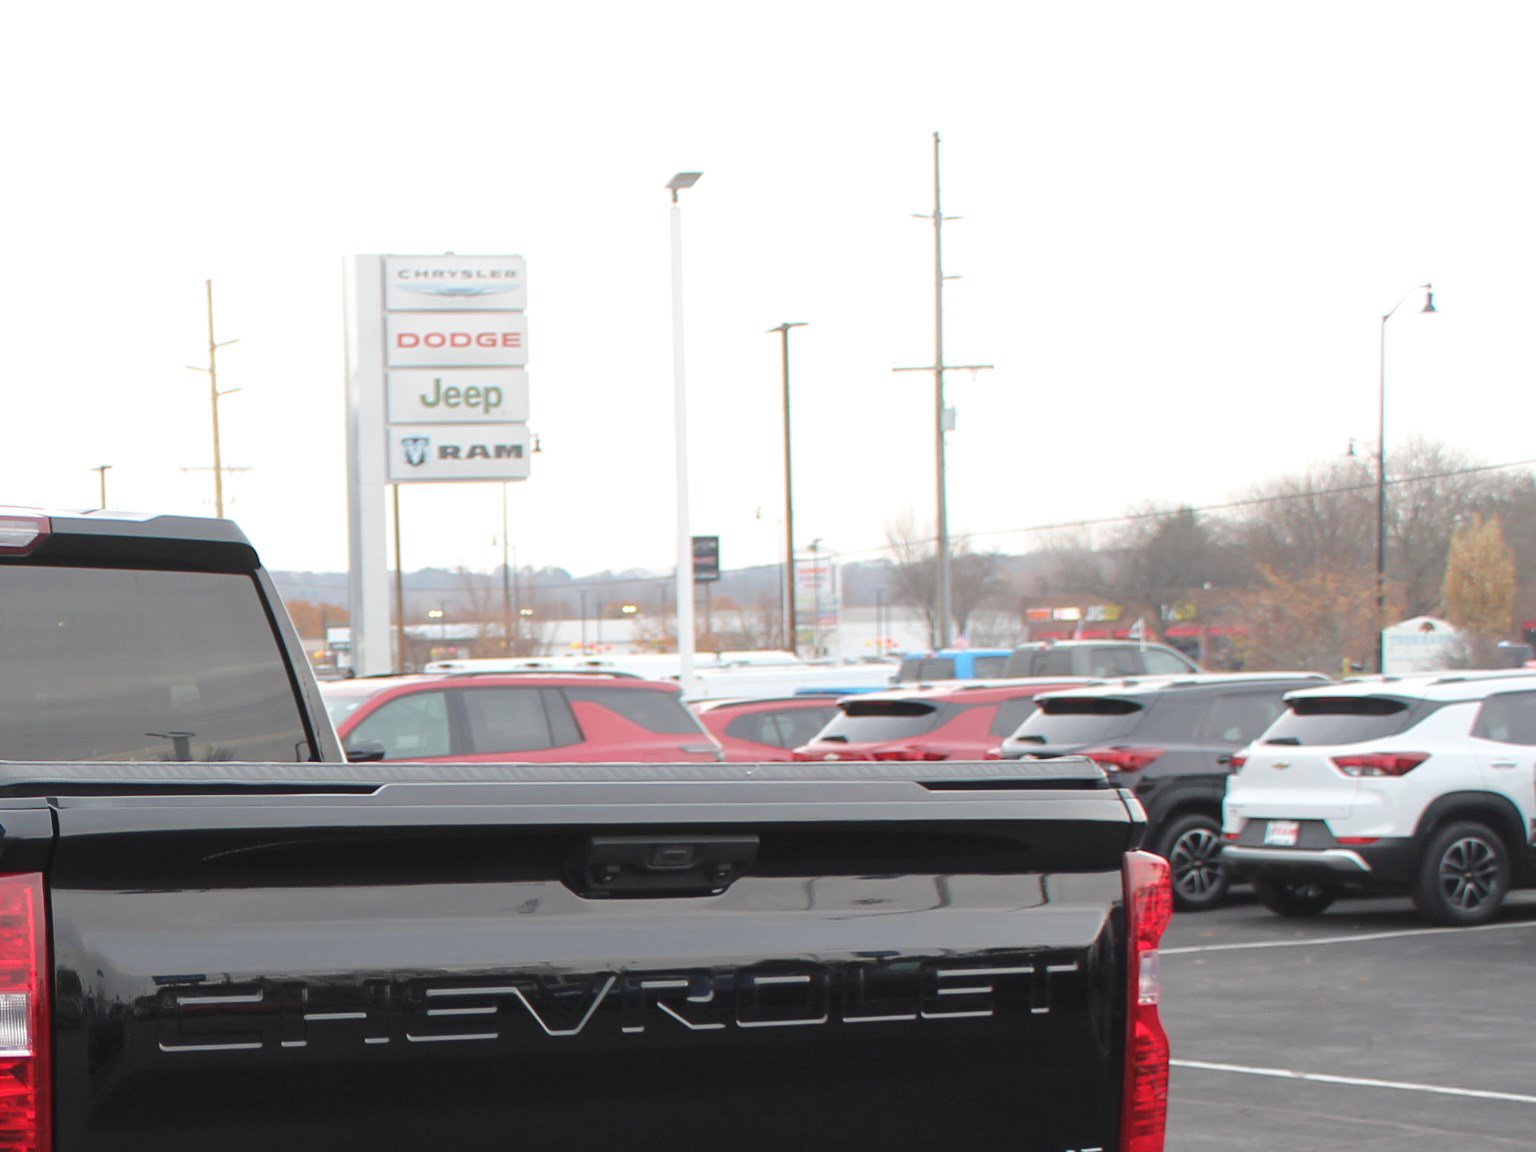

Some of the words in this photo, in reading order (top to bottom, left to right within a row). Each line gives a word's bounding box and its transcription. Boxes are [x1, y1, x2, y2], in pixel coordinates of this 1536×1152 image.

[397, 269, 519, 280] CHRYSLER
[396, 332, 522, 349] DODGE
[419, 377, 504, 414] Jeep
[437, 444, 524, 460] RAM
[158, 957, 1079, 1053] CHEVROLET
